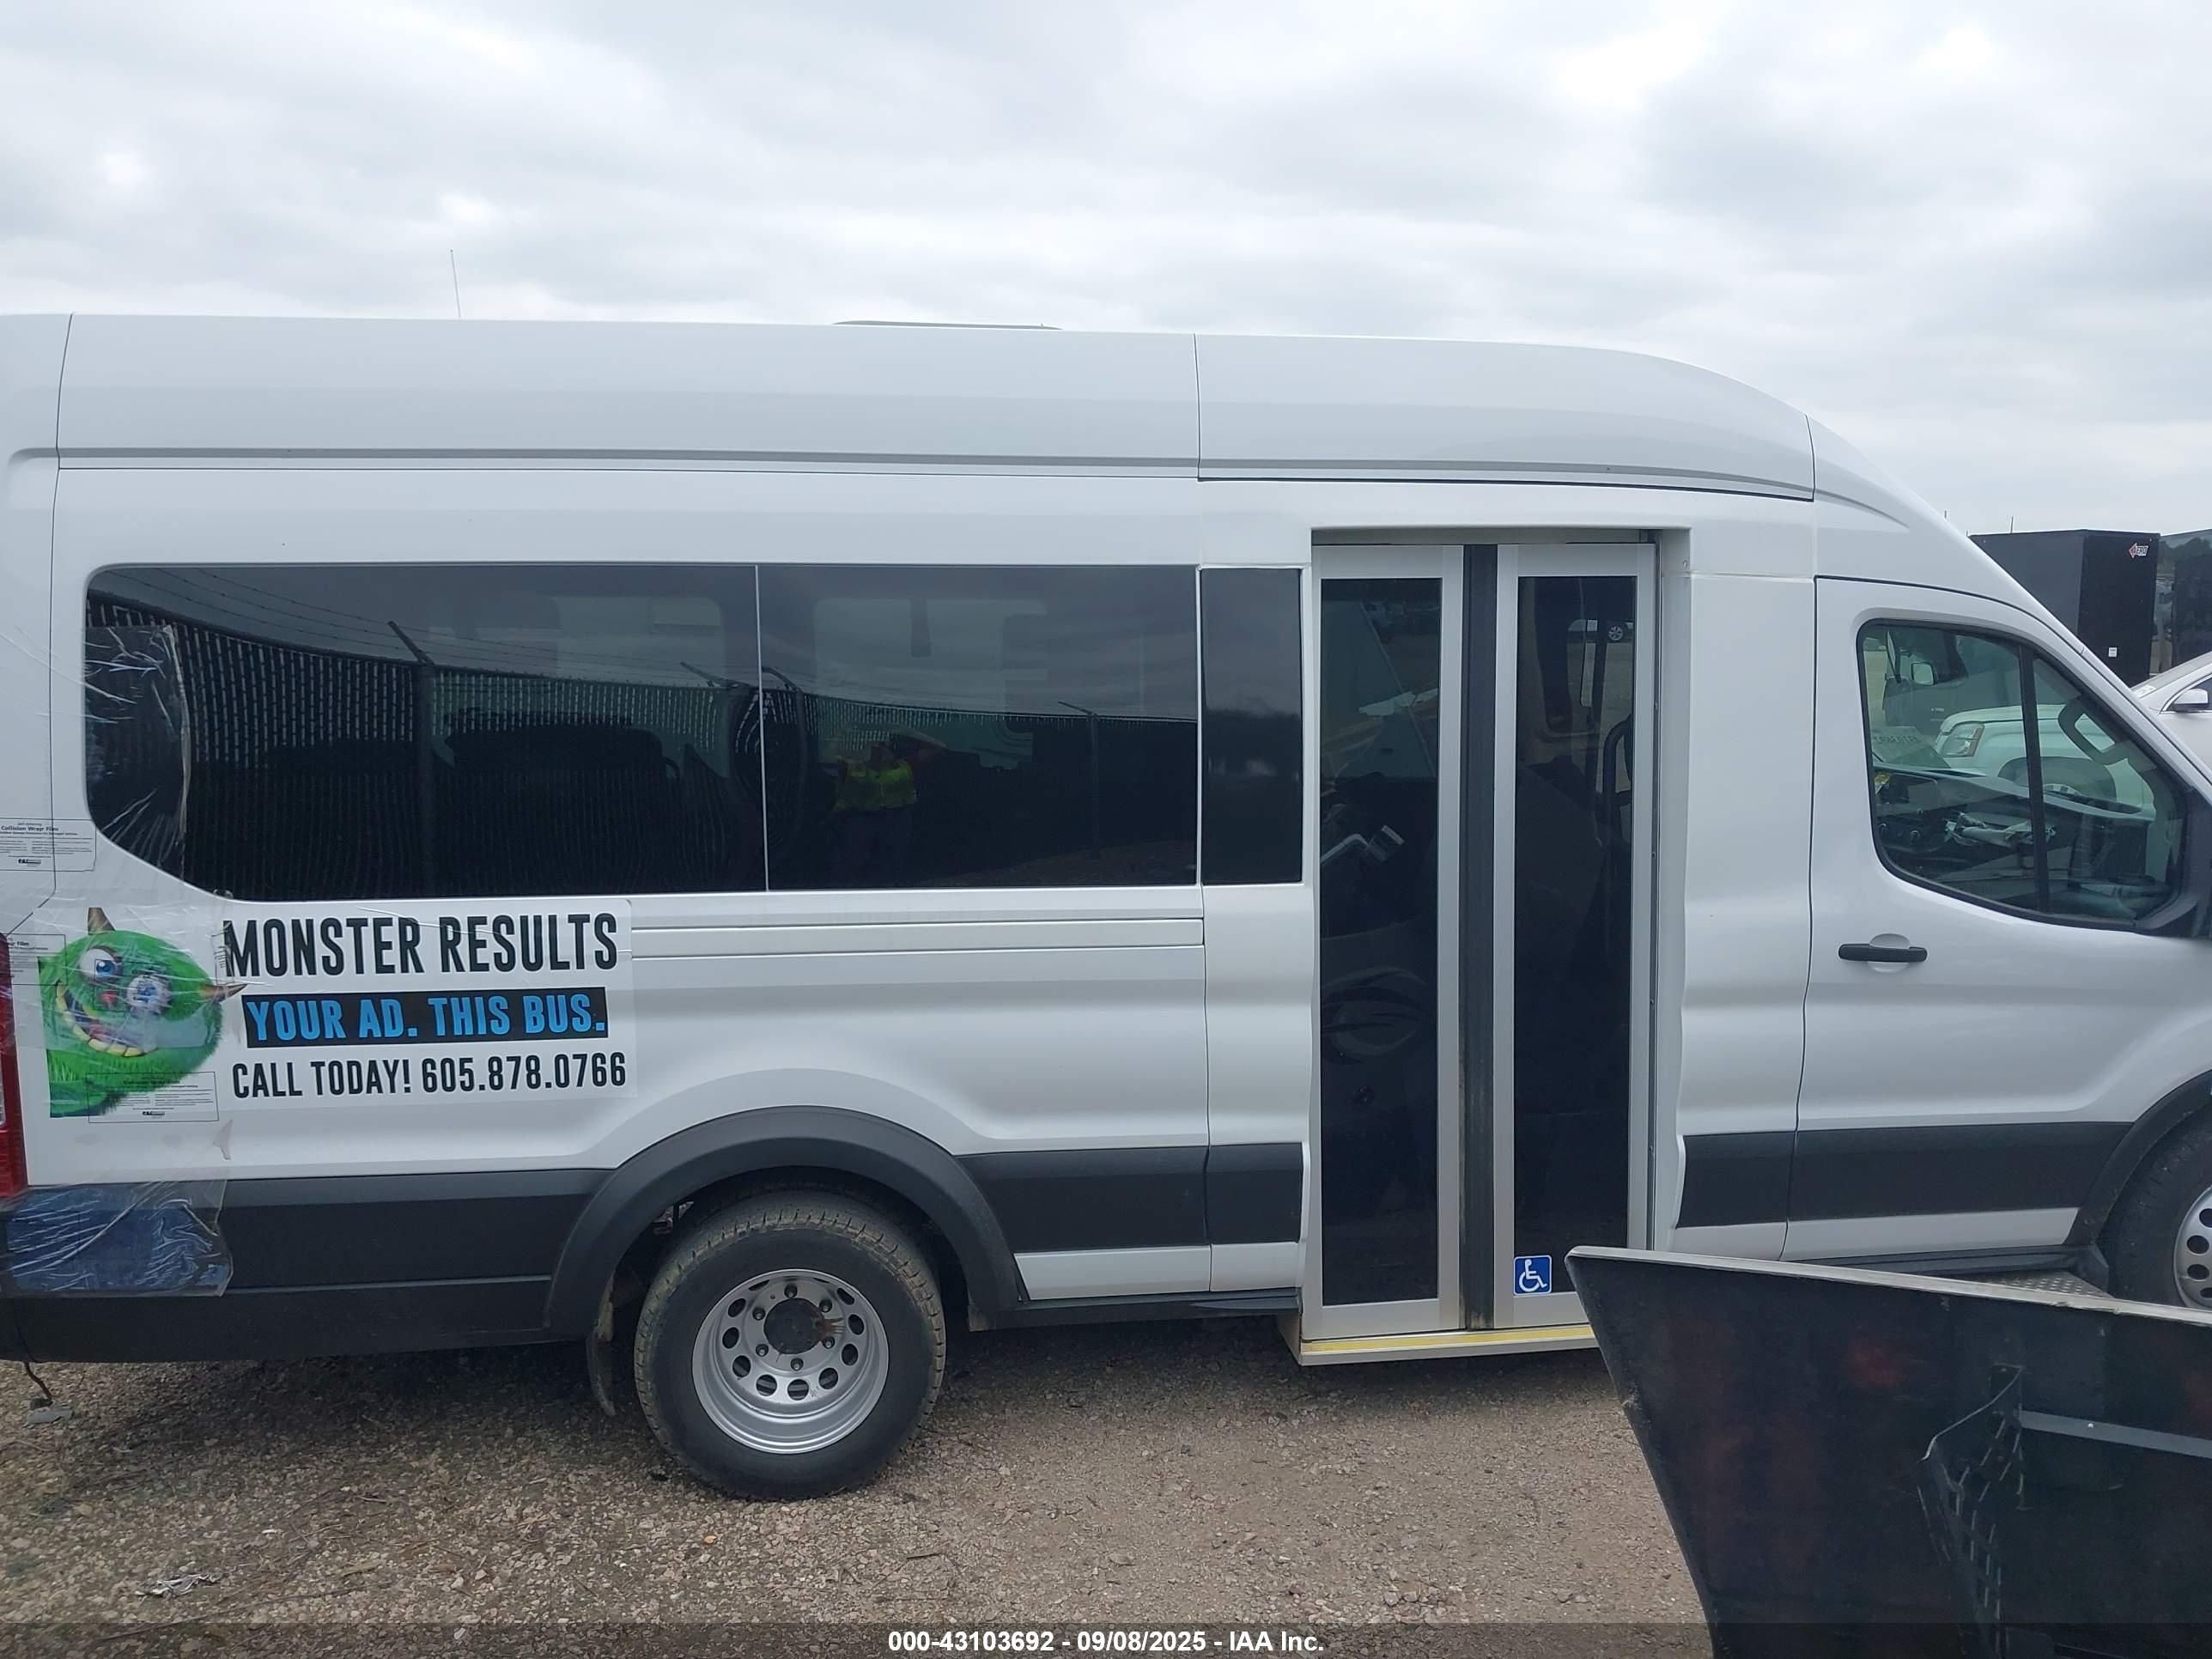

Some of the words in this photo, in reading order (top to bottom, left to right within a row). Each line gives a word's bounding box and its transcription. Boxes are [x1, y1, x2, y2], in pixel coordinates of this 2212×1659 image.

[223, 918, 424, 977] MONSTER
[439, 913, 617, 972] RESULTS
[246, 999, 346, 1041] YOUR
[359, 999, 417, 1037] AD.
[428, 996, 510, 1036] THIS
[523, 994, 605, 1033] BUS.
[232, 1062, 302, 1098] CALL
[310, 1060, 411, 1096] TODAY!
[422, 1052, 626, 1092] 605.878.0766
